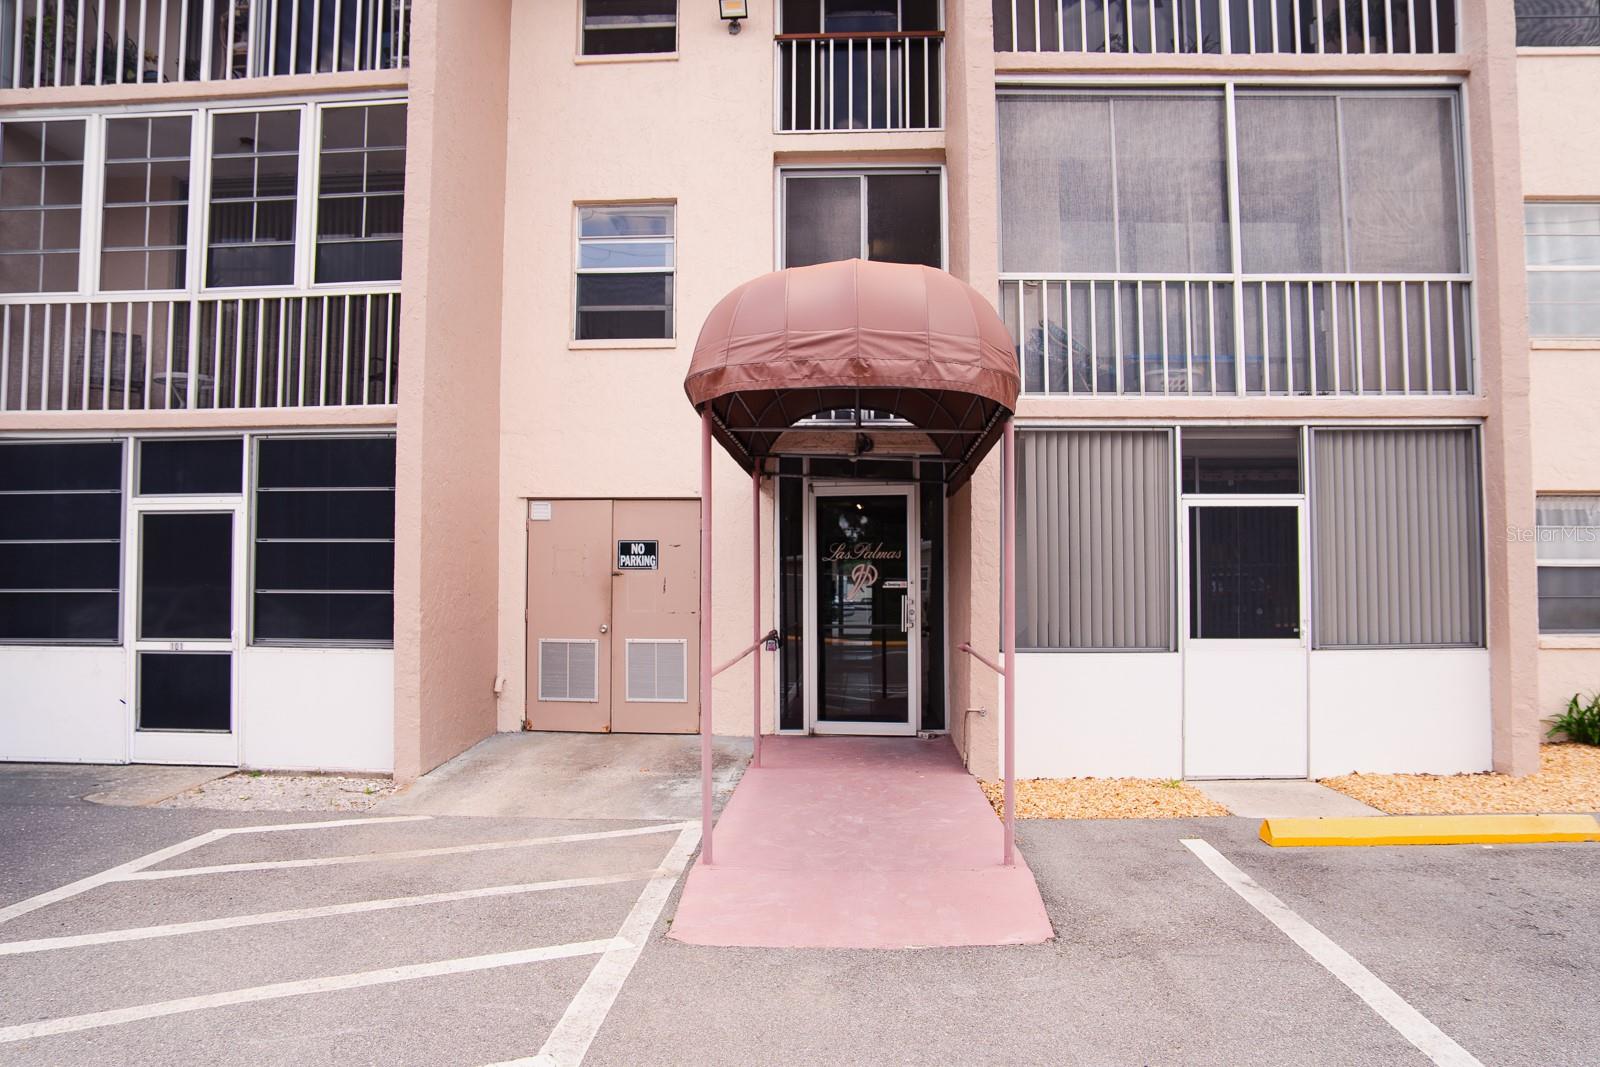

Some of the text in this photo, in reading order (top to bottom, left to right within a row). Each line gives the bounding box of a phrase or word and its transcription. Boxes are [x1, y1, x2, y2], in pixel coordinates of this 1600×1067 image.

[631, 543, 645, 554] NO
[822, 542, 902, 561] Las Palmas
[620, 555, 656, 567] PARKING
